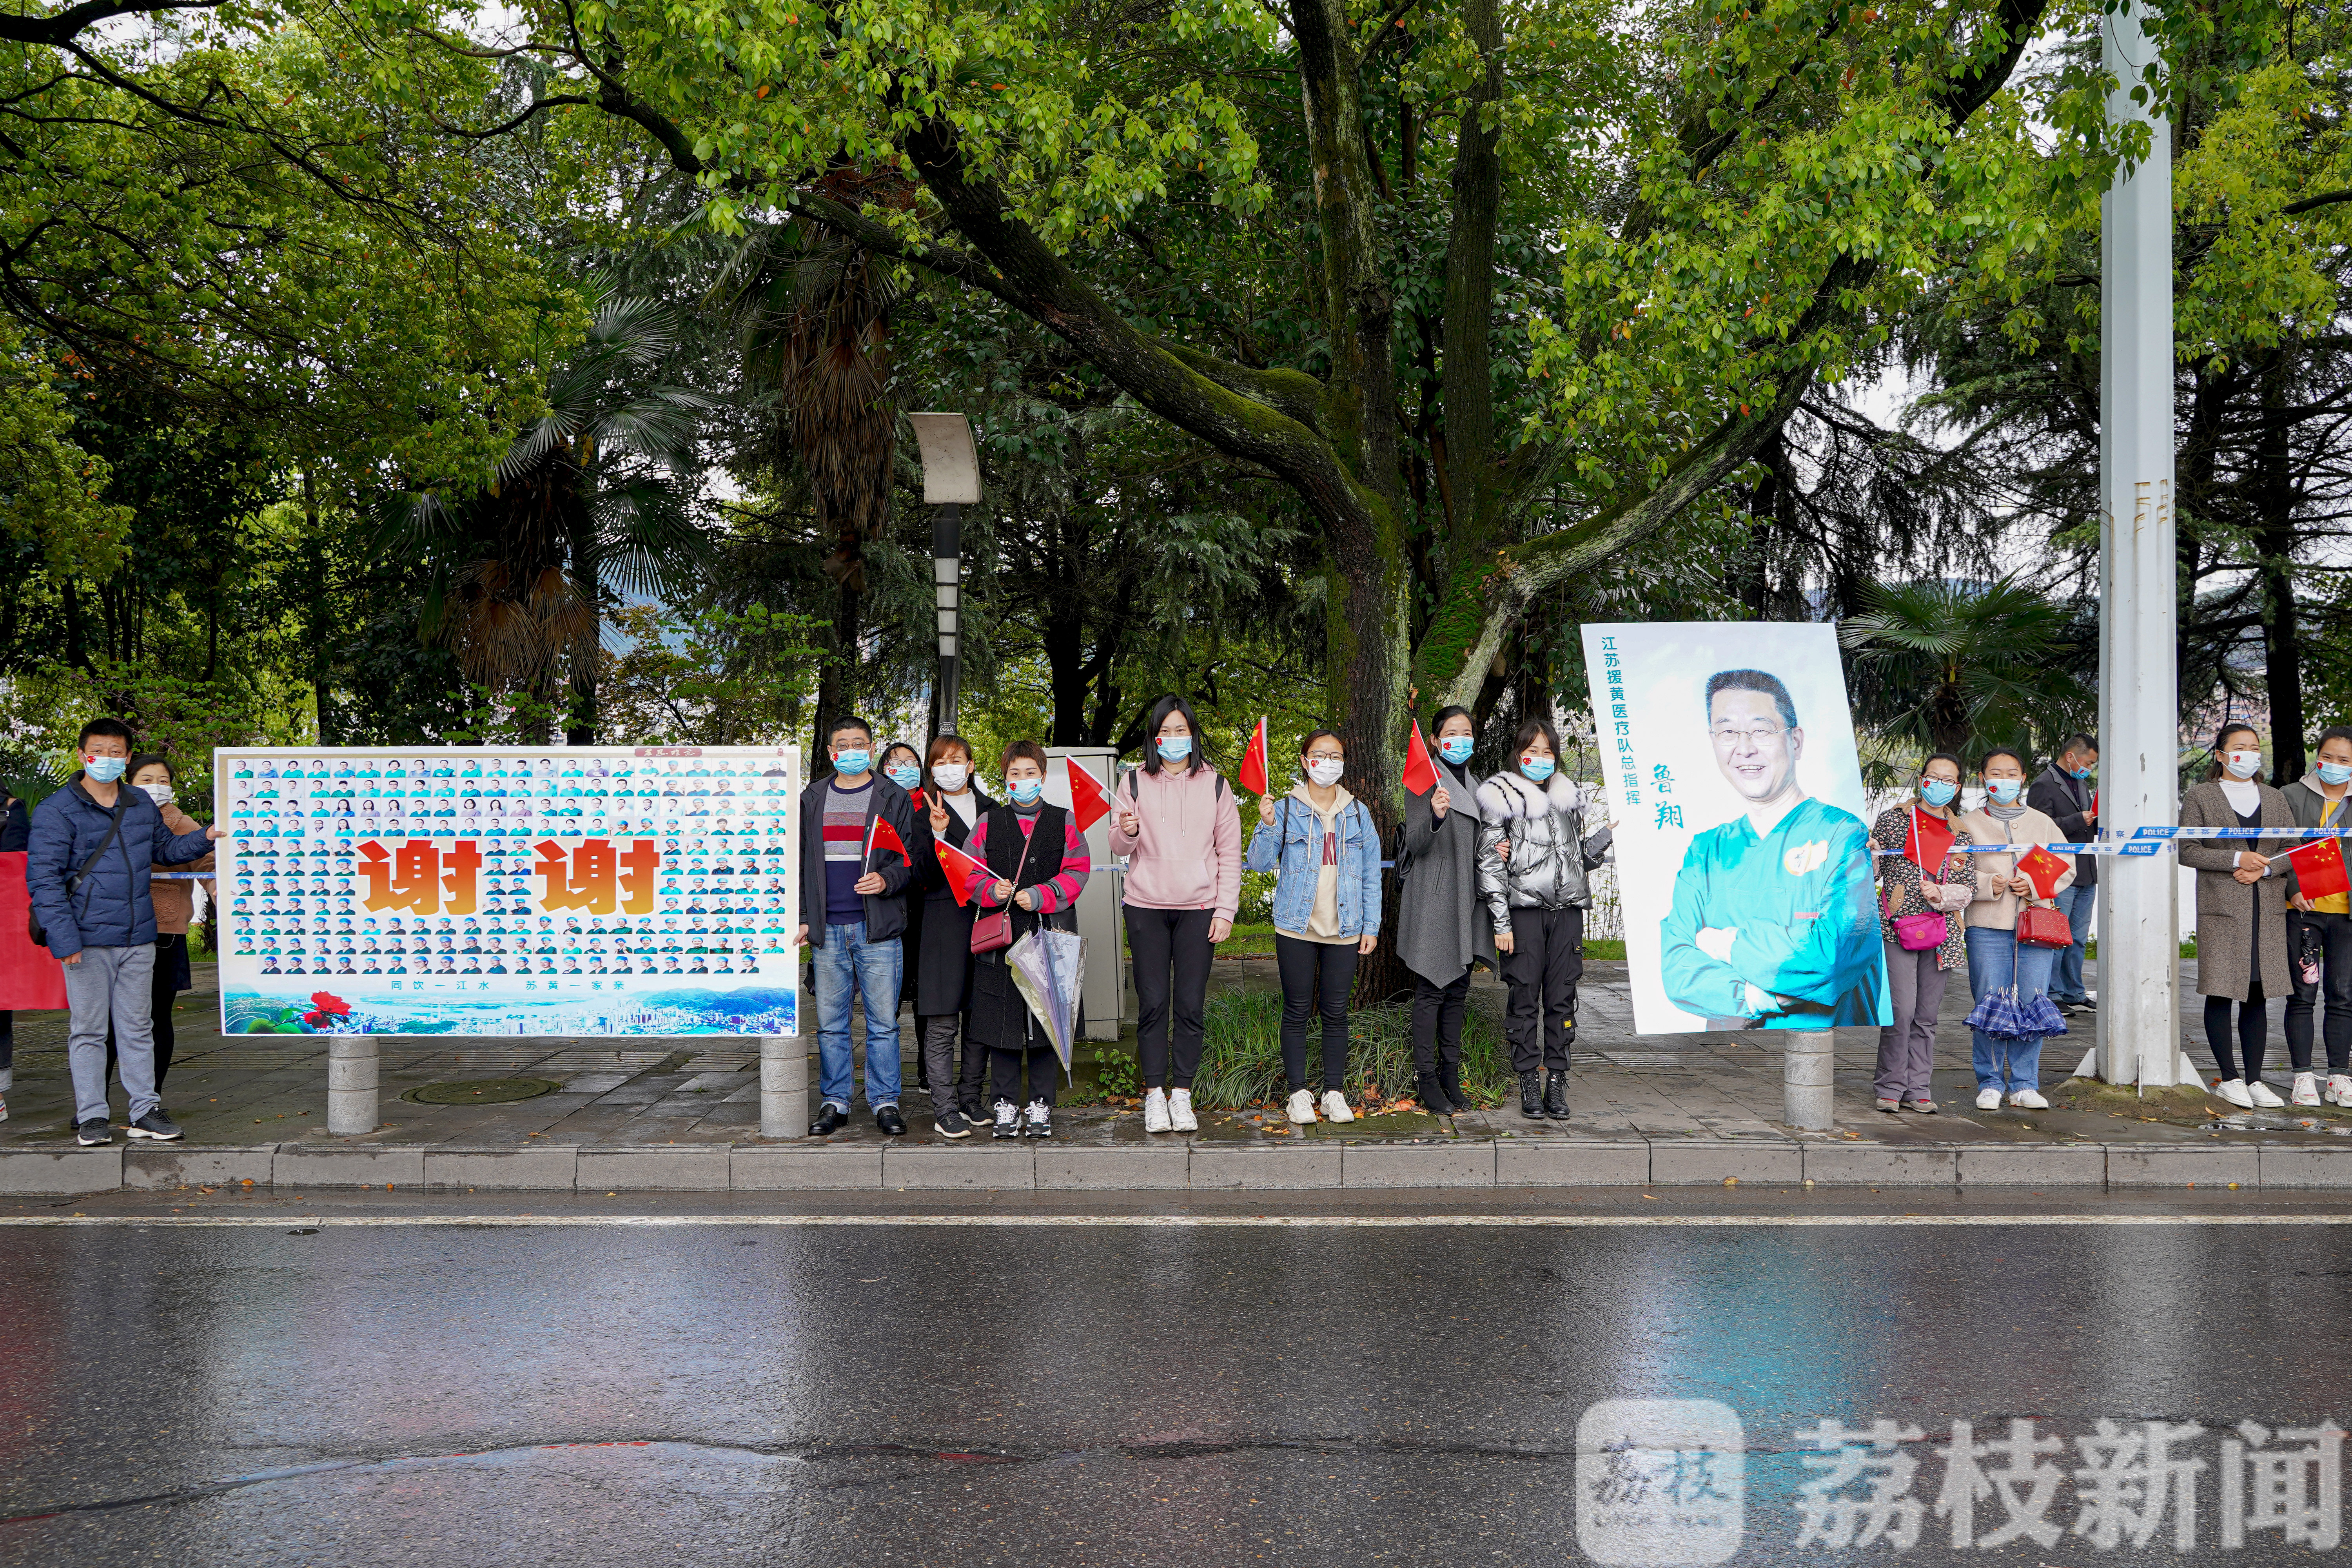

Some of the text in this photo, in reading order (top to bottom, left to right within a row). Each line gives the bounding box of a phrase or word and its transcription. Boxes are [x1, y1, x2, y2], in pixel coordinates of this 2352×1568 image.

[1602, 637, 1641, 805] 江苏援黄医疗队总指挥
[1650, 764, 1684, 830] 鲁翔
[356, 840, 660, 915] 谢谢
[391, 980, 624, 990] 同饮一江水 苏黄一家亲
